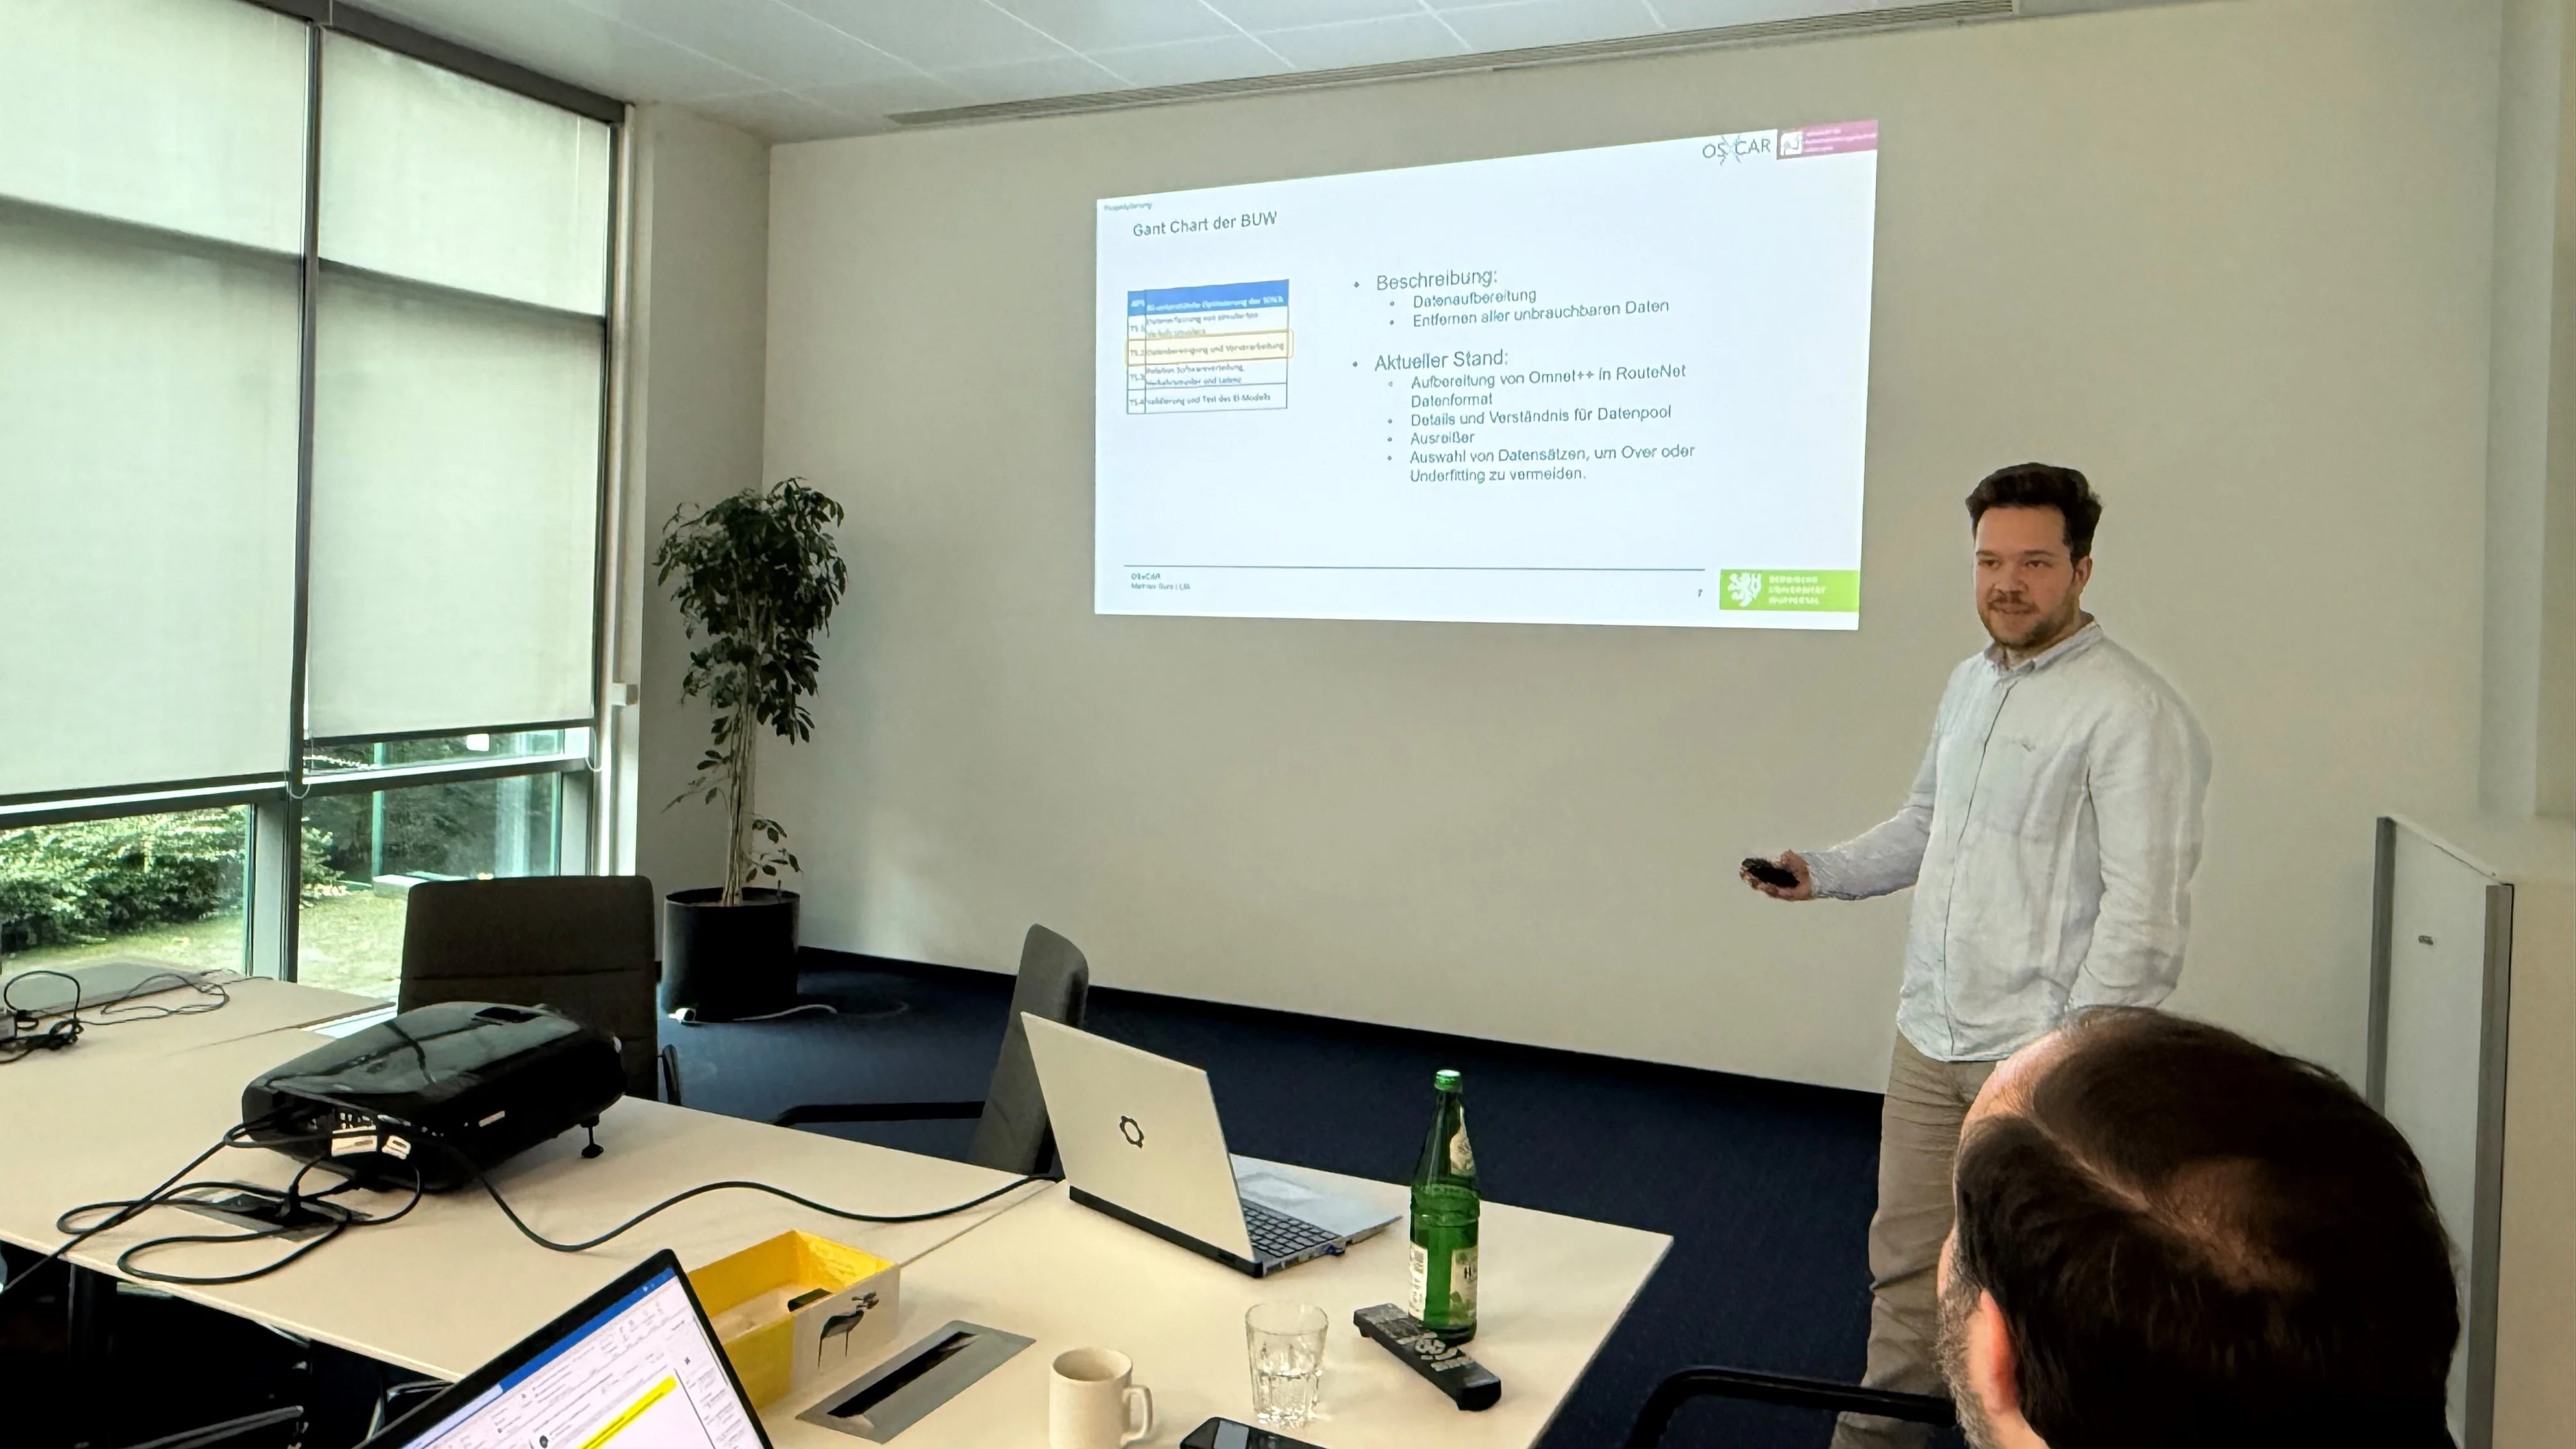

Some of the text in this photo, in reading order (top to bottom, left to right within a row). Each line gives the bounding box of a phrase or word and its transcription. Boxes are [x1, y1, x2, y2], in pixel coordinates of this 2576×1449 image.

[1133, 211, 1277, 236] Gant Chart der BUW
[1377, 269, 1498, 291] Beschreibung:
[1413, 289, 1536, 308] Datenaufbereitung
[1413, 300, 1669, 327] Entfernen aller unbrauchbaren Daten
[1375, 349, 1508, 372] Aktueller Stand:
[1411, 364, 1687, 389] Aufbereitung von Omnet++ in RouteNet
[1411, 392, 1492, 408] Datenformat
[1411, 405, 1671, 426] Details und Verständnis für Datenpool
[1410, 432, 1475, 446] Ausreißer
[1409, 444, 1695, 464] Auswahl von Datensätzen, um Over oder
[1410, 467, 1586, 484] Underfitting zu vermeiden.
